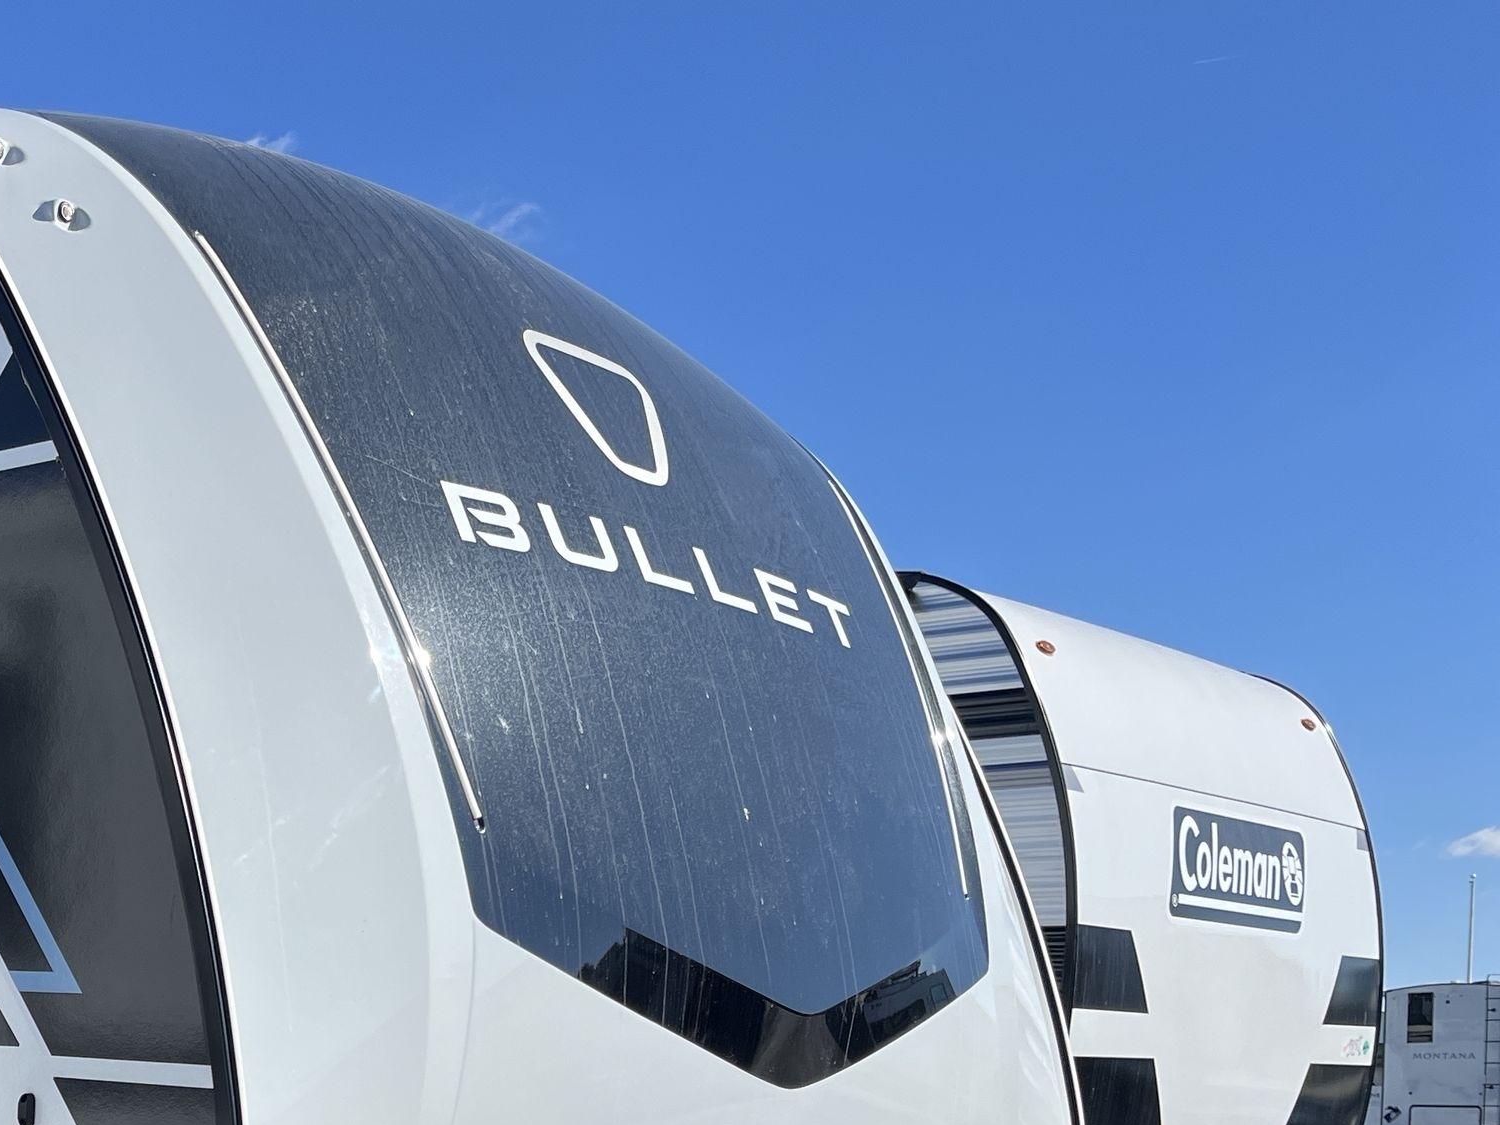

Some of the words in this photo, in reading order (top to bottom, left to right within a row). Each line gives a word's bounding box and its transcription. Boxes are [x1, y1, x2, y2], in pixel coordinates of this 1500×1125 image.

[440, 480, 851, 648] BULLET
[1179, 815, 1281, 900] Coleman
[1412, 1052, 1476, 1060] MONTANA
